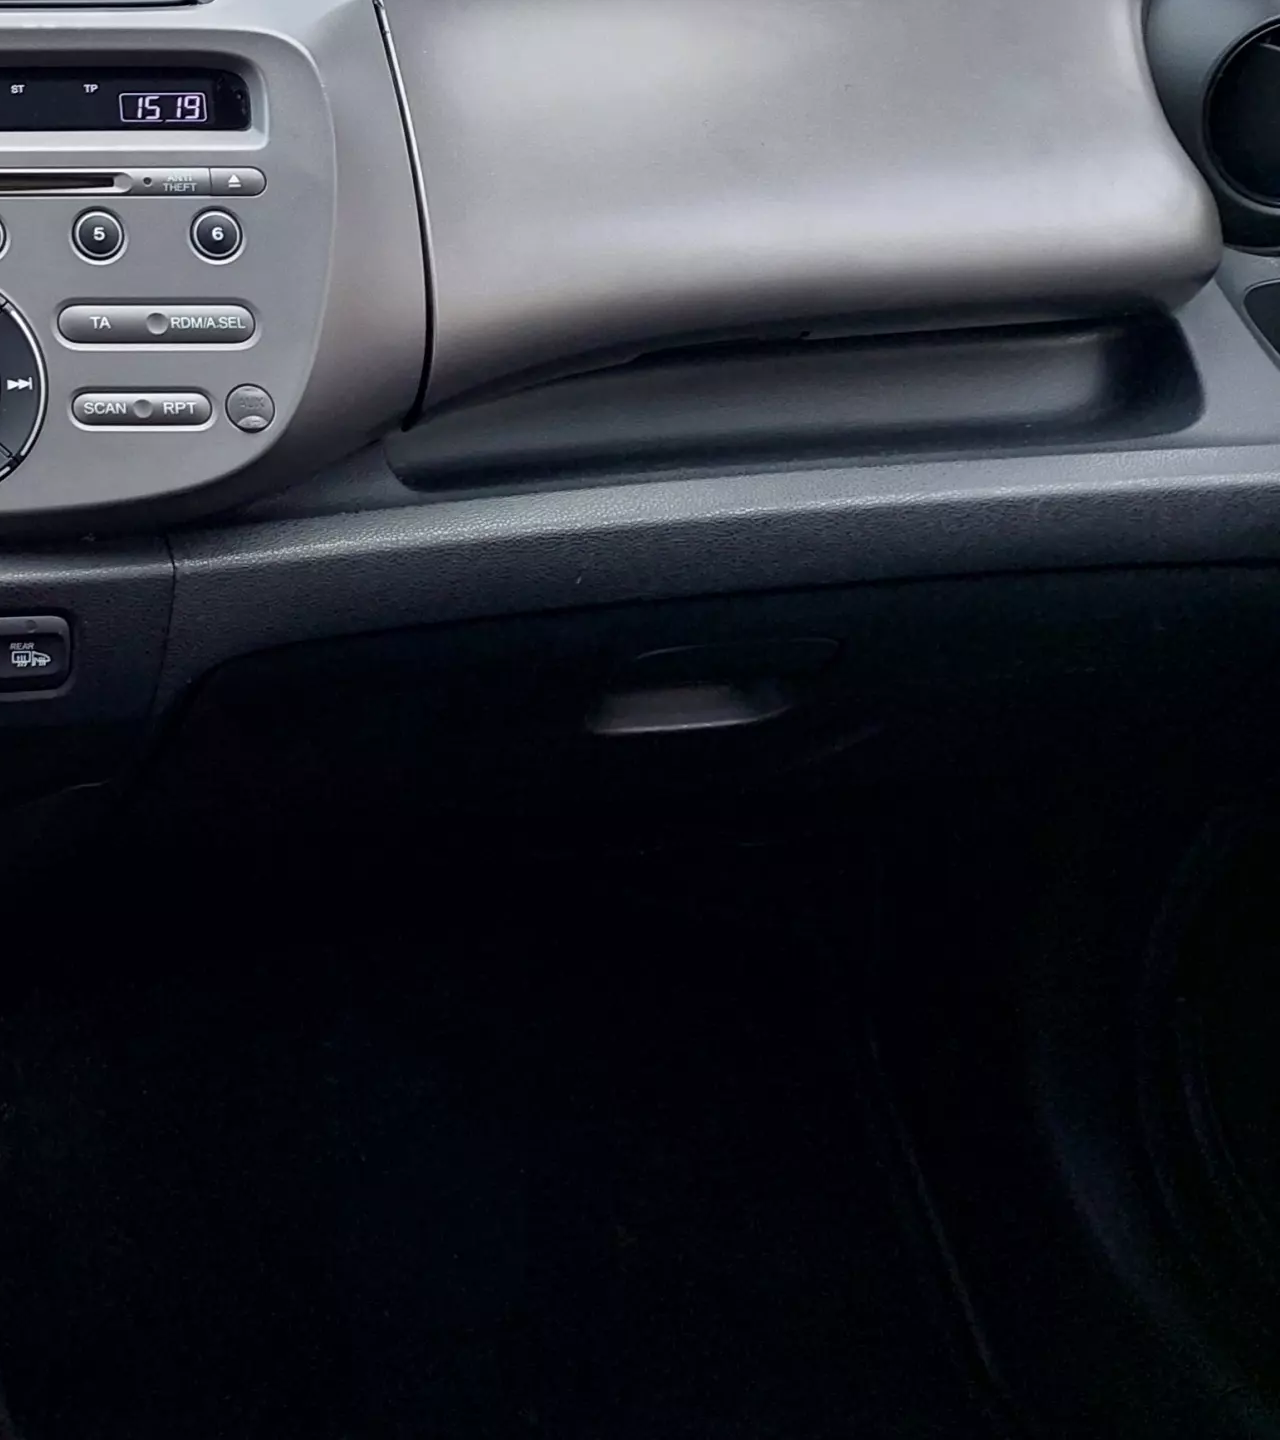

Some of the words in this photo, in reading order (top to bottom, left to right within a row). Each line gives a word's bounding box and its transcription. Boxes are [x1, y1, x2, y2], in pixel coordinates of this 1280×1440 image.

[10, 85, 25, 94] ST
[83, 84, 99, 93] TP
[162, 182, 198, 192] THEFT
[93, 227, 106, 241] 5
[211, 227, 224, 241] 6
[90, 316, 112, 330] TA
[83, 401, 127, 416] SCAN
[163, 401, 196, 416] RPT
[9, 642, 35, 650] REAR
